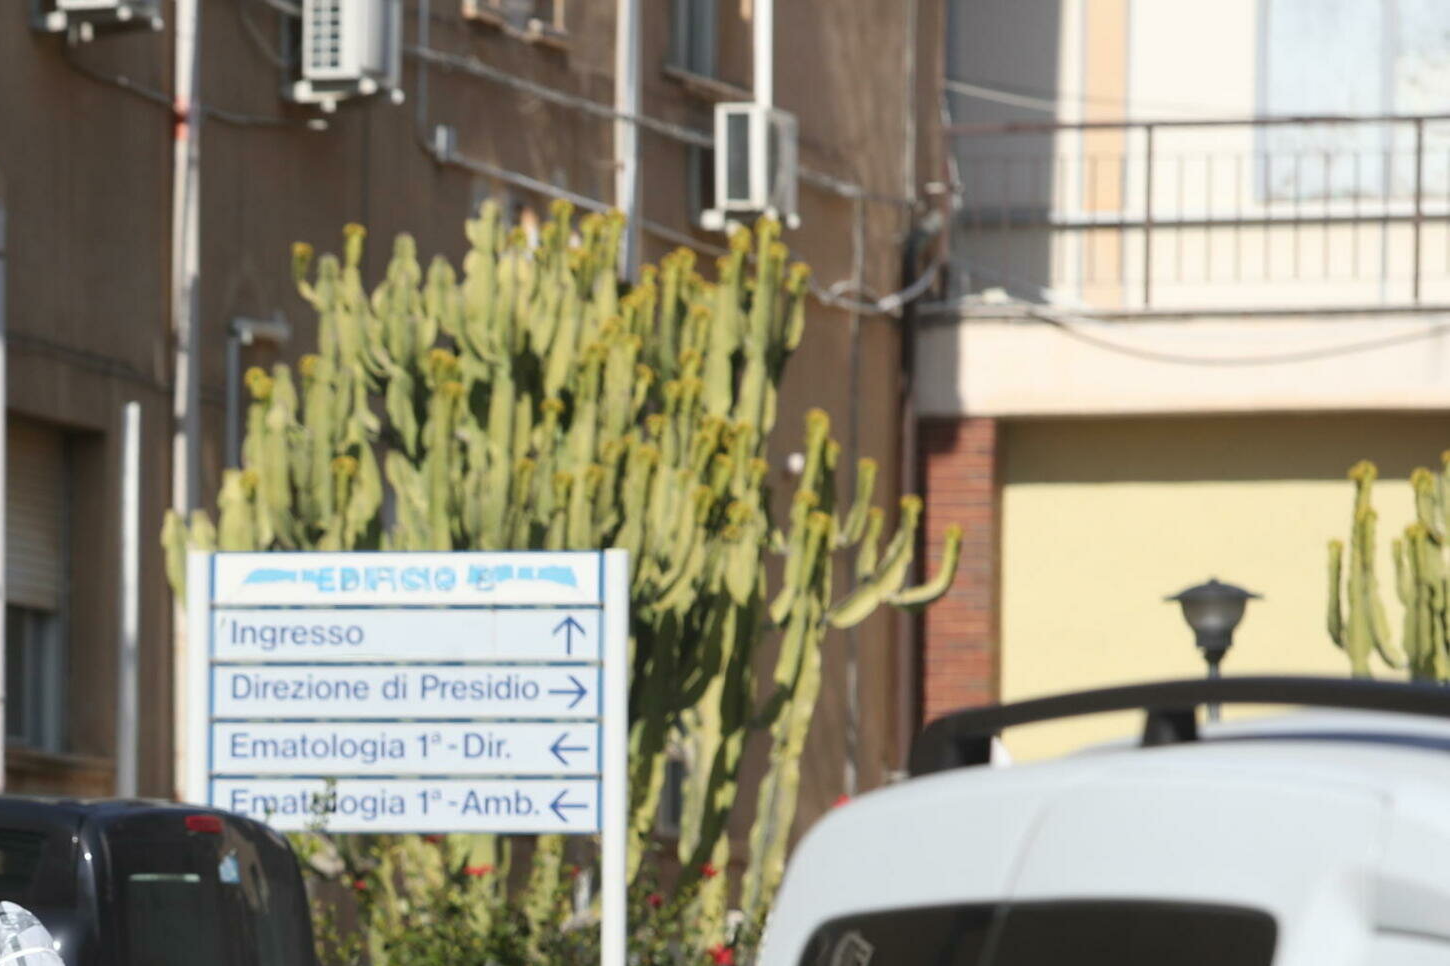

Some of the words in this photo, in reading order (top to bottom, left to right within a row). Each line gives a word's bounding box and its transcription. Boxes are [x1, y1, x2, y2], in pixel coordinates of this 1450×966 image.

[231, 620, 365, 650] Ingresso
[231, 674, 369, 701] Direzione
[382, 674, 407, 701] di
[420, 674, 540, 701] Presidio
[231, 732, 405, 763] Ematologia
[231, 789, 405, 820] Ematogia
